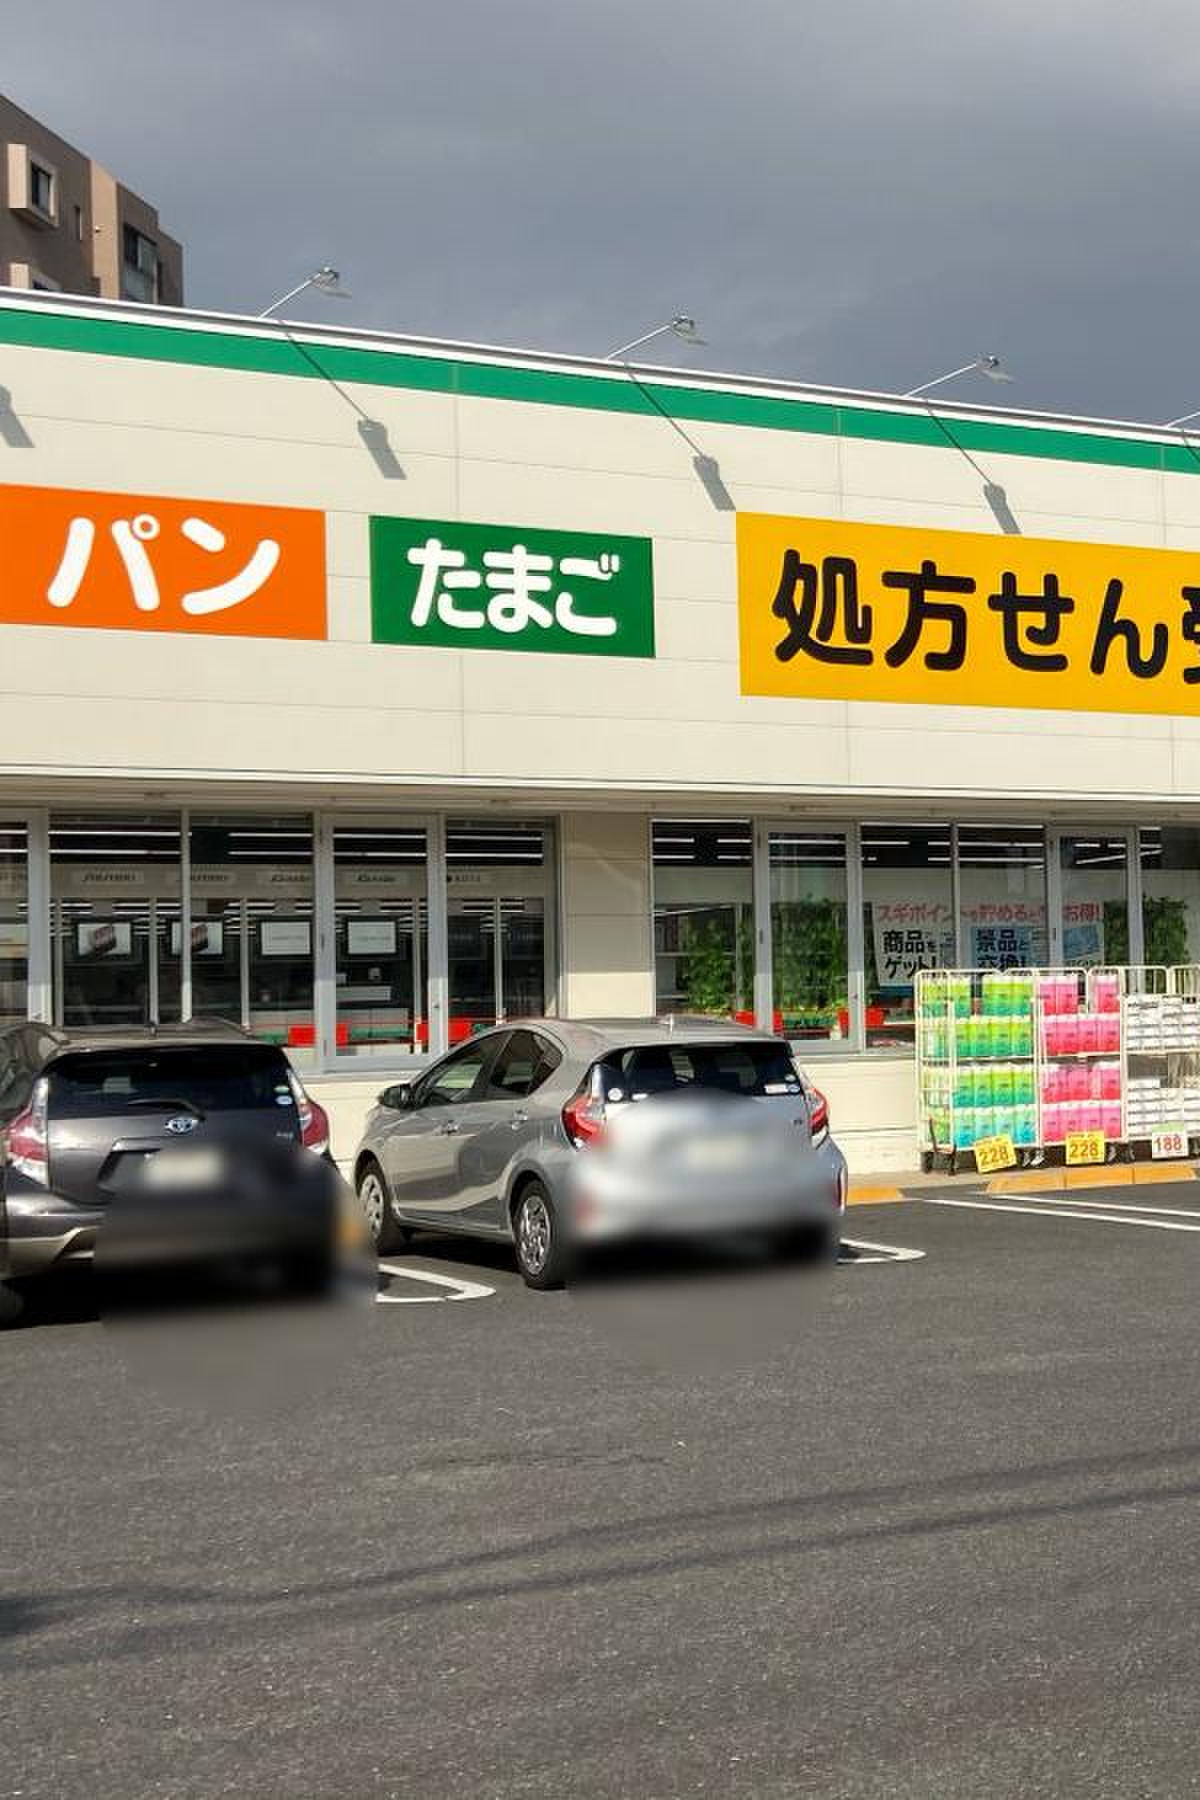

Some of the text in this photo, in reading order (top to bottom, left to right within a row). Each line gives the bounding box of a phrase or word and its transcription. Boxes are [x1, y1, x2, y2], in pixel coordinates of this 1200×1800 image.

[47, 513, 280, 615] パン
[407, 538, 620, 636] たまご
[978, 1145, 1009, 1166] 228
[1069, 1142, 1099, 1158] 228
